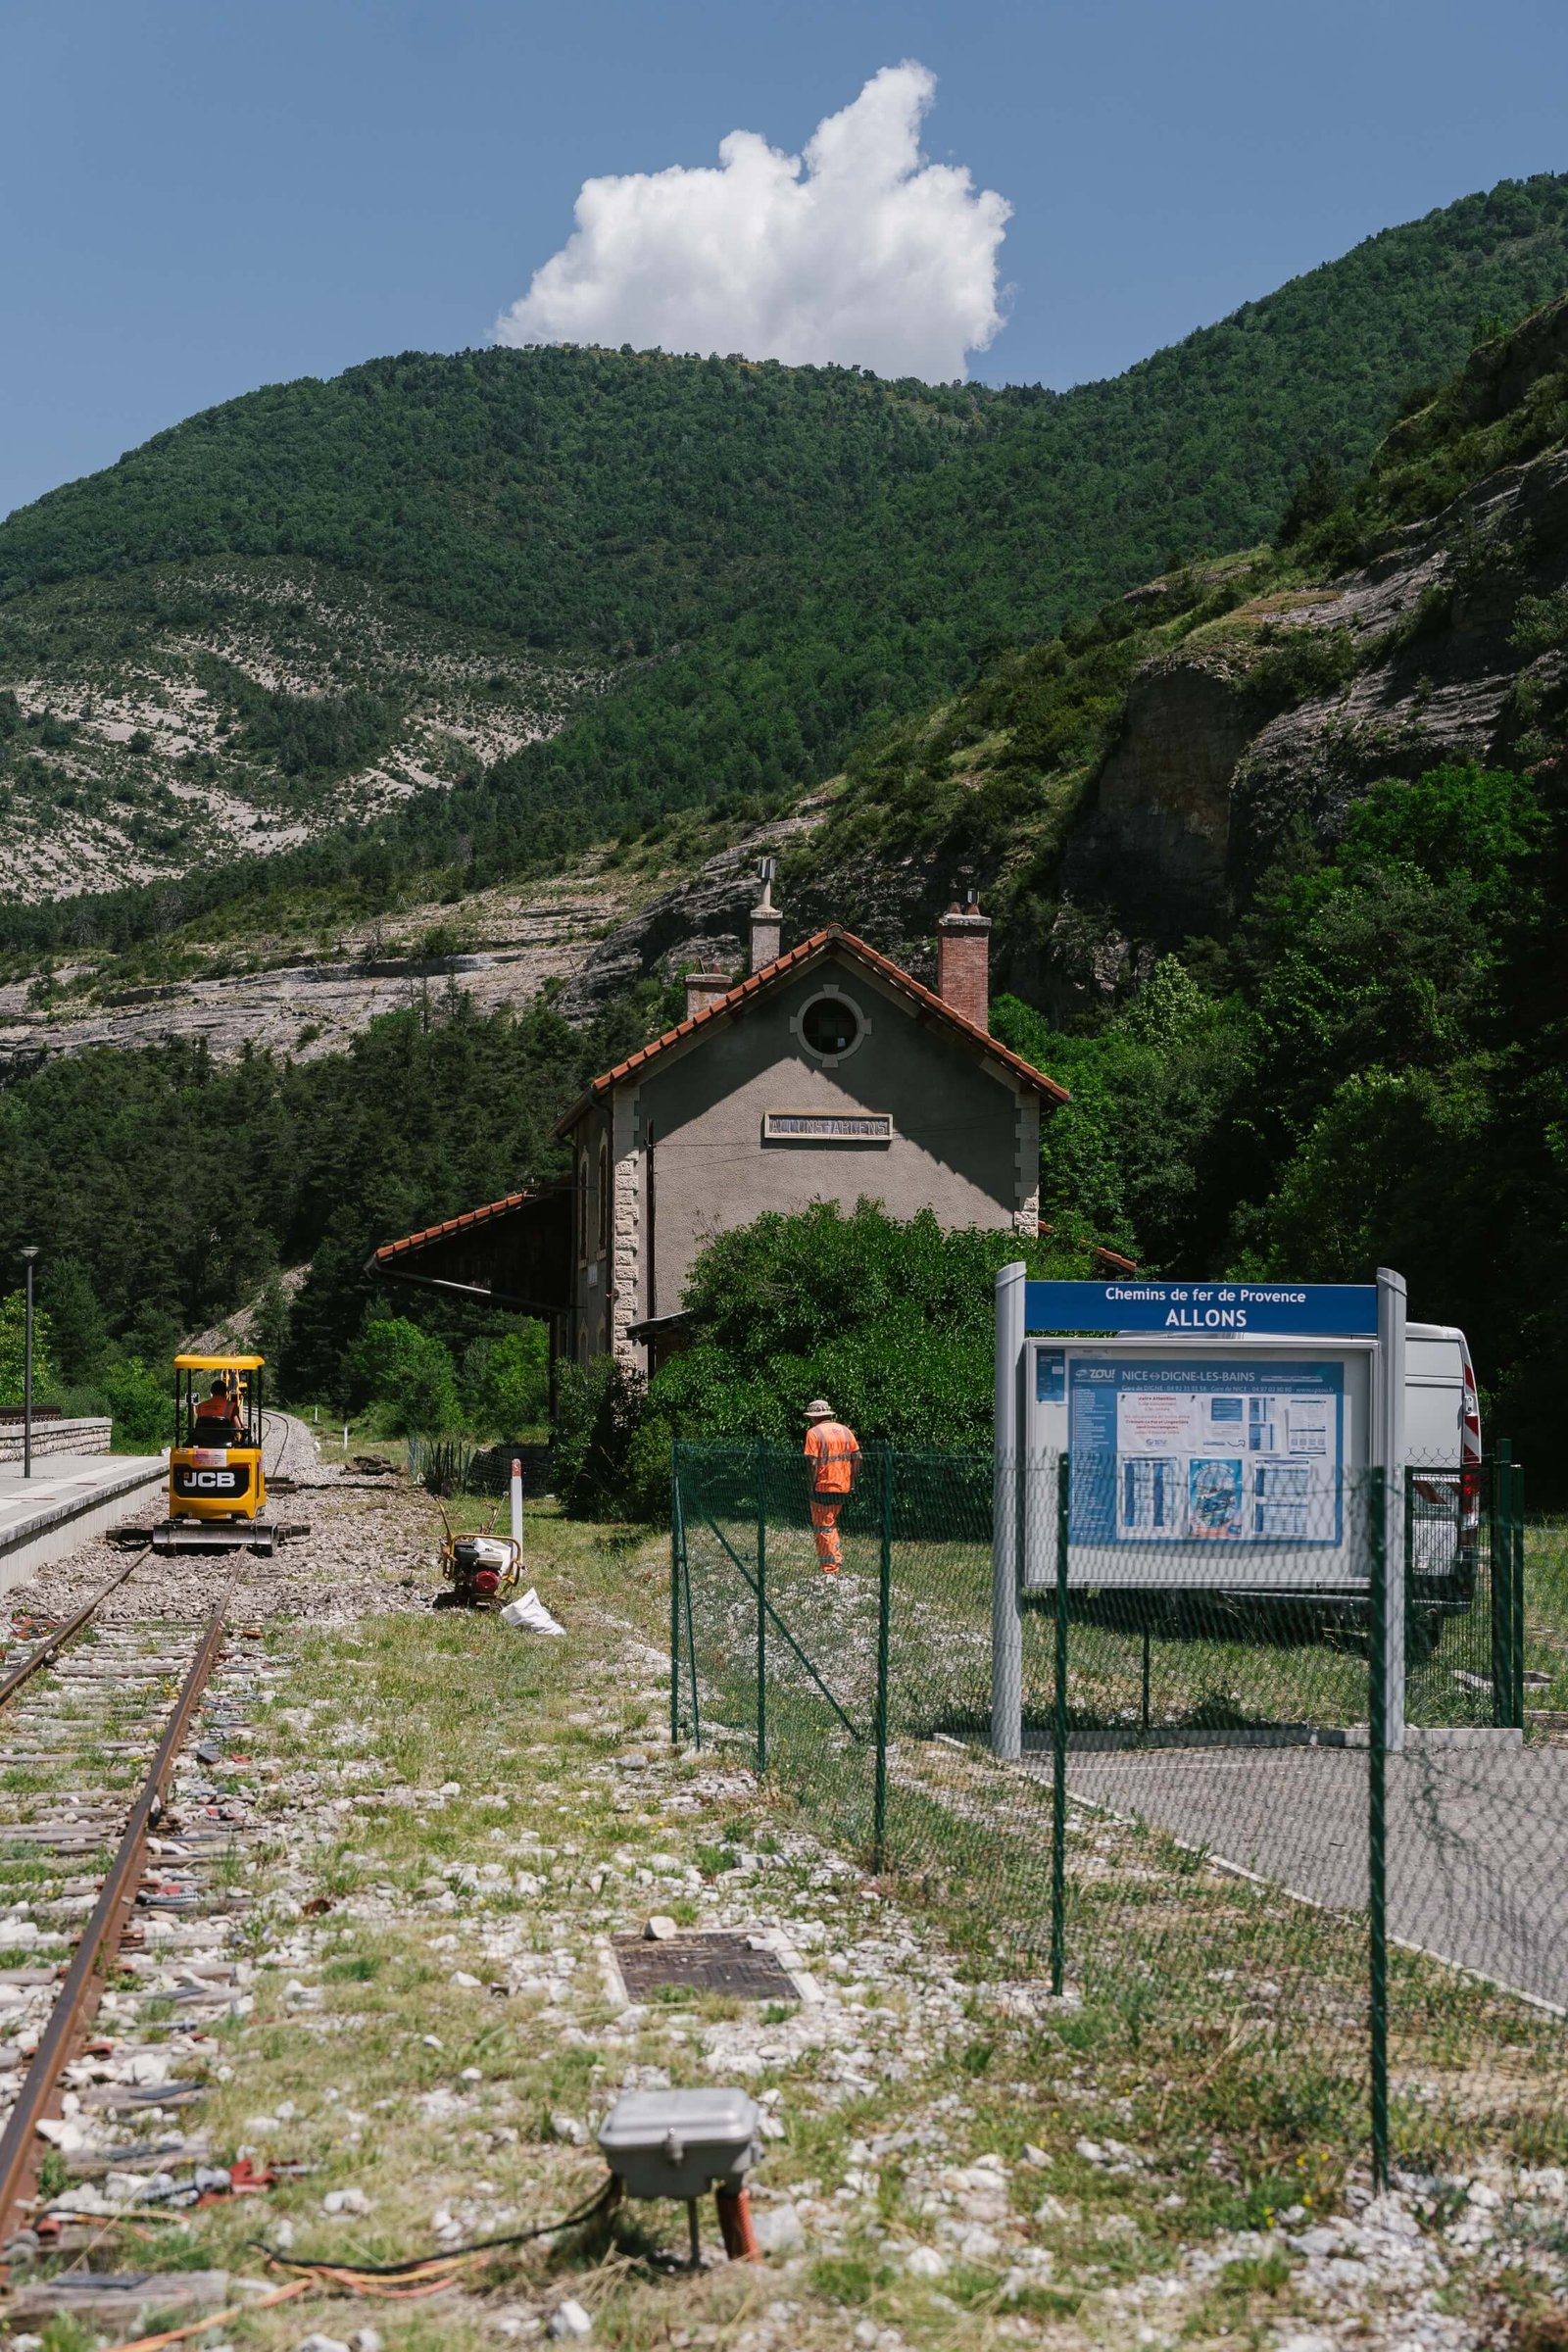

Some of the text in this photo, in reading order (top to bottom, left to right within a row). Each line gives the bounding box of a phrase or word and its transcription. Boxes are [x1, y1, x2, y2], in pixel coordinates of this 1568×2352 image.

[1105, 1287, 1306, 1302] Chemins de fer de Provence
[1165, 1308, 1248, 1327] ALLONS
[1088, 1369, 1115, 1379] ZOU!
[1121, 1370, 1255, 1382] NICE DIGNE-LES-BAINS
[183, 1472, 235, 1487] JCB
